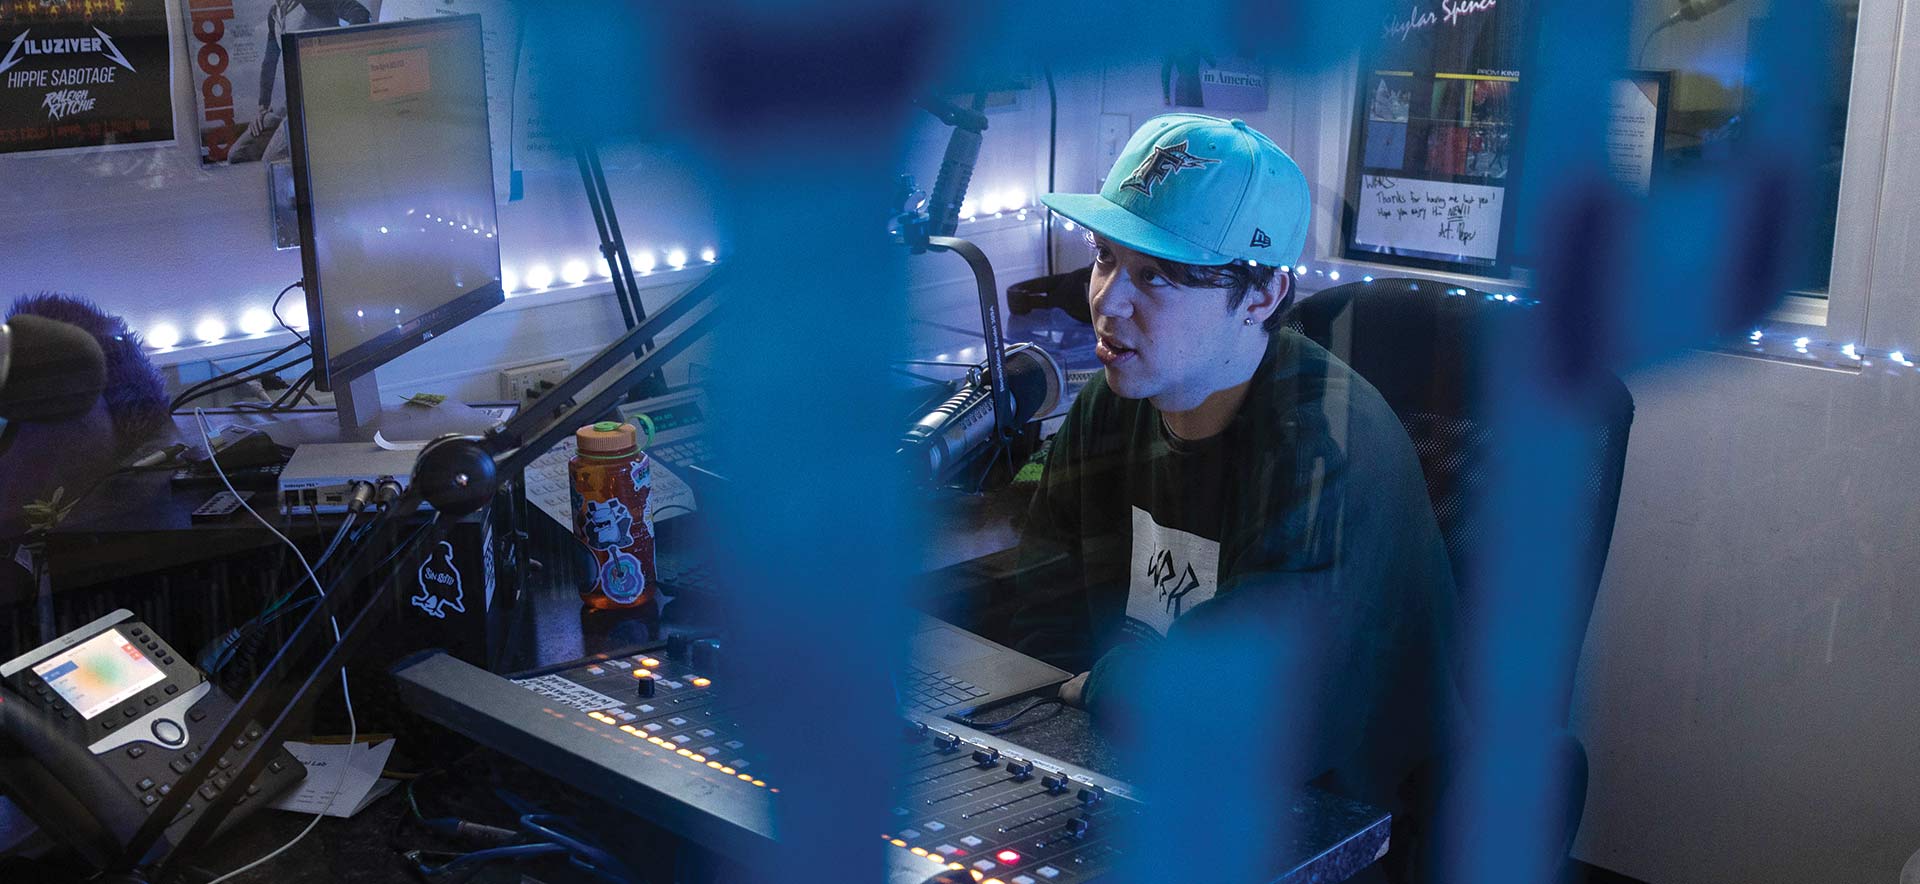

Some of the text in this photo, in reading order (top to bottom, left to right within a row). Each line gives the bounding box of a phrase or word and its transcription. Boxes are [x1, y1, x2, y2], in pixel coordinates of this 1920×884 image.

[8, 66, 117, 89] HIPPIE SABOTAGE
[1203, 70, 1262, 88] in America
[1476, 68, 1520, 78] PROM KING
